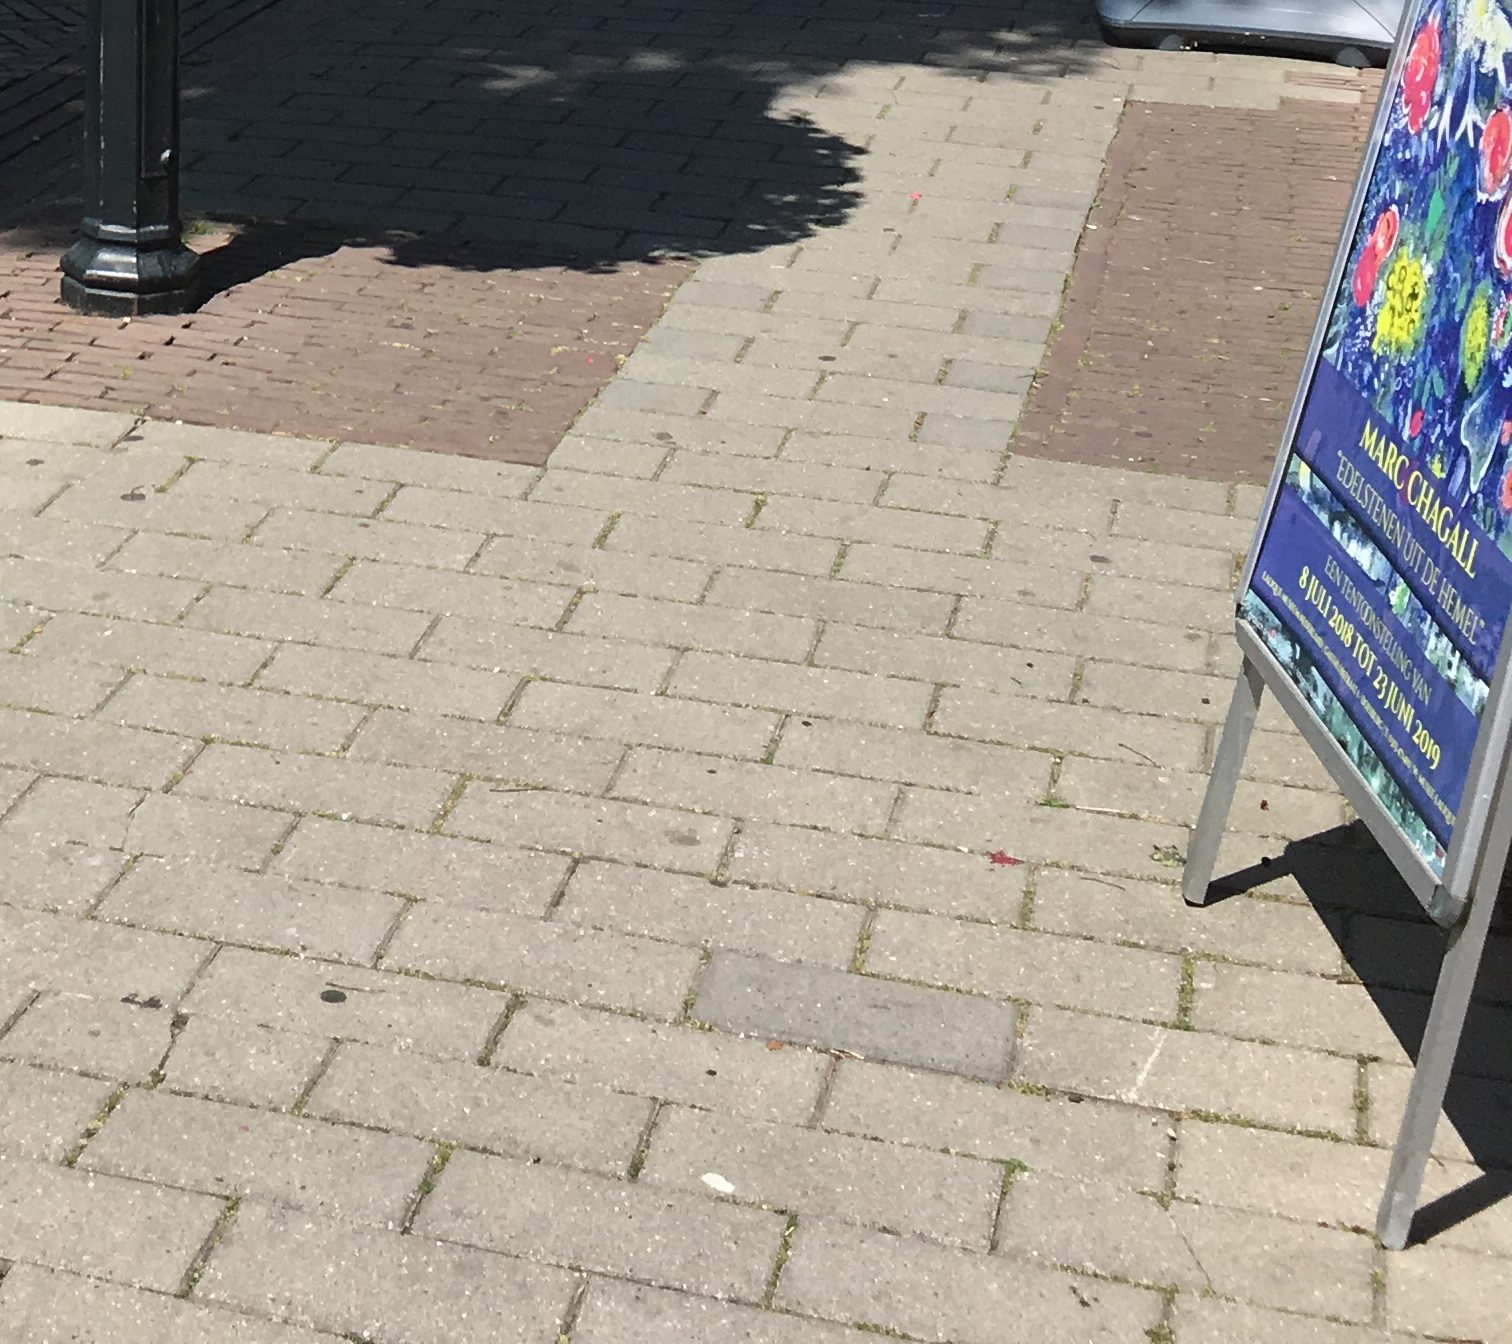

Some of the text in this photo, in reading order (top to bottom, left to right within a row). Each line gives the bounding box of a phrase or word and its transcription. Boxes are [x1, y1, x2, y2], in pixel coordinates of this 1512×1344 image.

[1358, 418, 1479, 579] MARC CHAGALL
[1402, 532, 1426, 573] UIT
[1420, 558, 1441, 595] DE
[1299, 566, 1441, 770] 8 JULI 2018 TOT 23 JUNI 2019
[1324, 554, 1432, 705] EEN TENTOONSTELLING VAN
